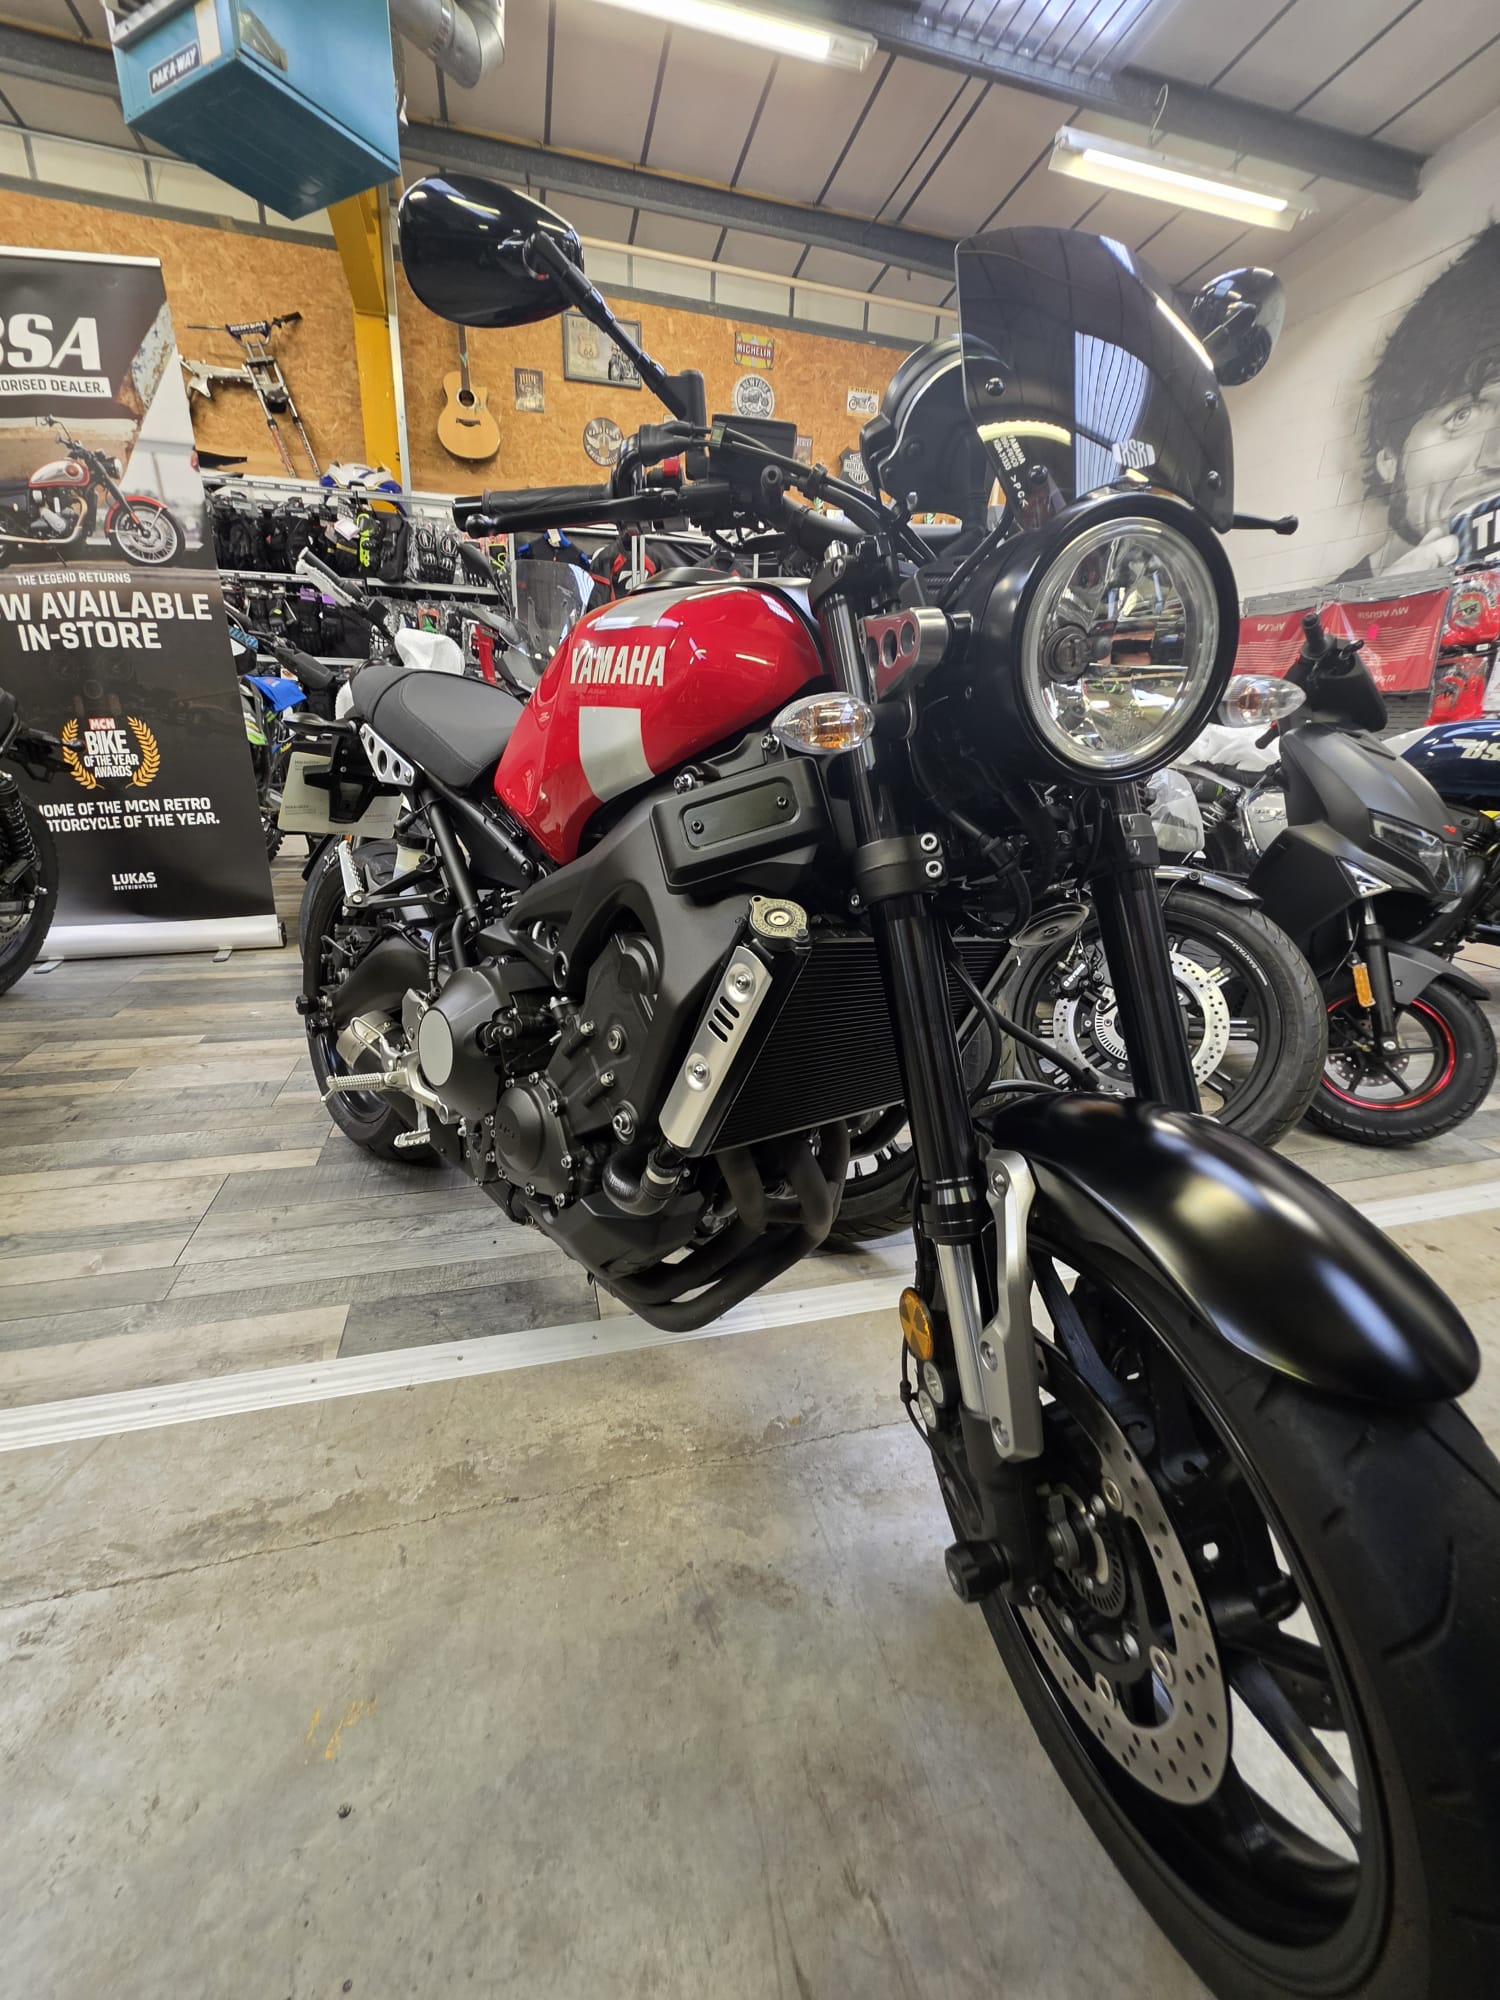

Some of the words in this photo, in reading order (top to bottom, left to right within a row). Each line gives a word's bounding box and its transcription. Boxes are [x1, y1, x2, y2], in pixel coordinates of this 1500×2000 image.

[0, 313, 101, 370] SA
[736, 343, 773, 359] MICHELIN
[50, 380, 105, 393] DEALER.
[1121, 438, 1148, 469] XSR
[16, 574, 37, 586] THE
[38, 572, 76, 585] LEGEND
[79, 571, 131, 584] RETURNS
[0, 593, 31, 621] W
[42, 590, 213, 621] AVAILABLE
[17, 621, 162, 652] IN-STORE
[570, 646, 666, 686] YAMAHA
[90, 718, 115, 730] MCN
[84, 730, 130, 755] BIKE
[84, 755, 95, 767] OF
[95, 755, 112, 766] THE
[112, 753, 139, 766] YEAR
[94, 766, 132, 778] AWARDS
[78, 802, 95, 815] OF
[96, 800, 122, 814] THE
[124, 798, 160, 813] MCN
[163, 797, 211, 811] RETRO
[124, 816, 142, 829] OF
[145, 815, 175, 828] THE
[176, 812, 220, 826] YEAR.
[112, 872, 157, 885] LUKAS
[114, 883, 158, 891] DISTRIBUTION
